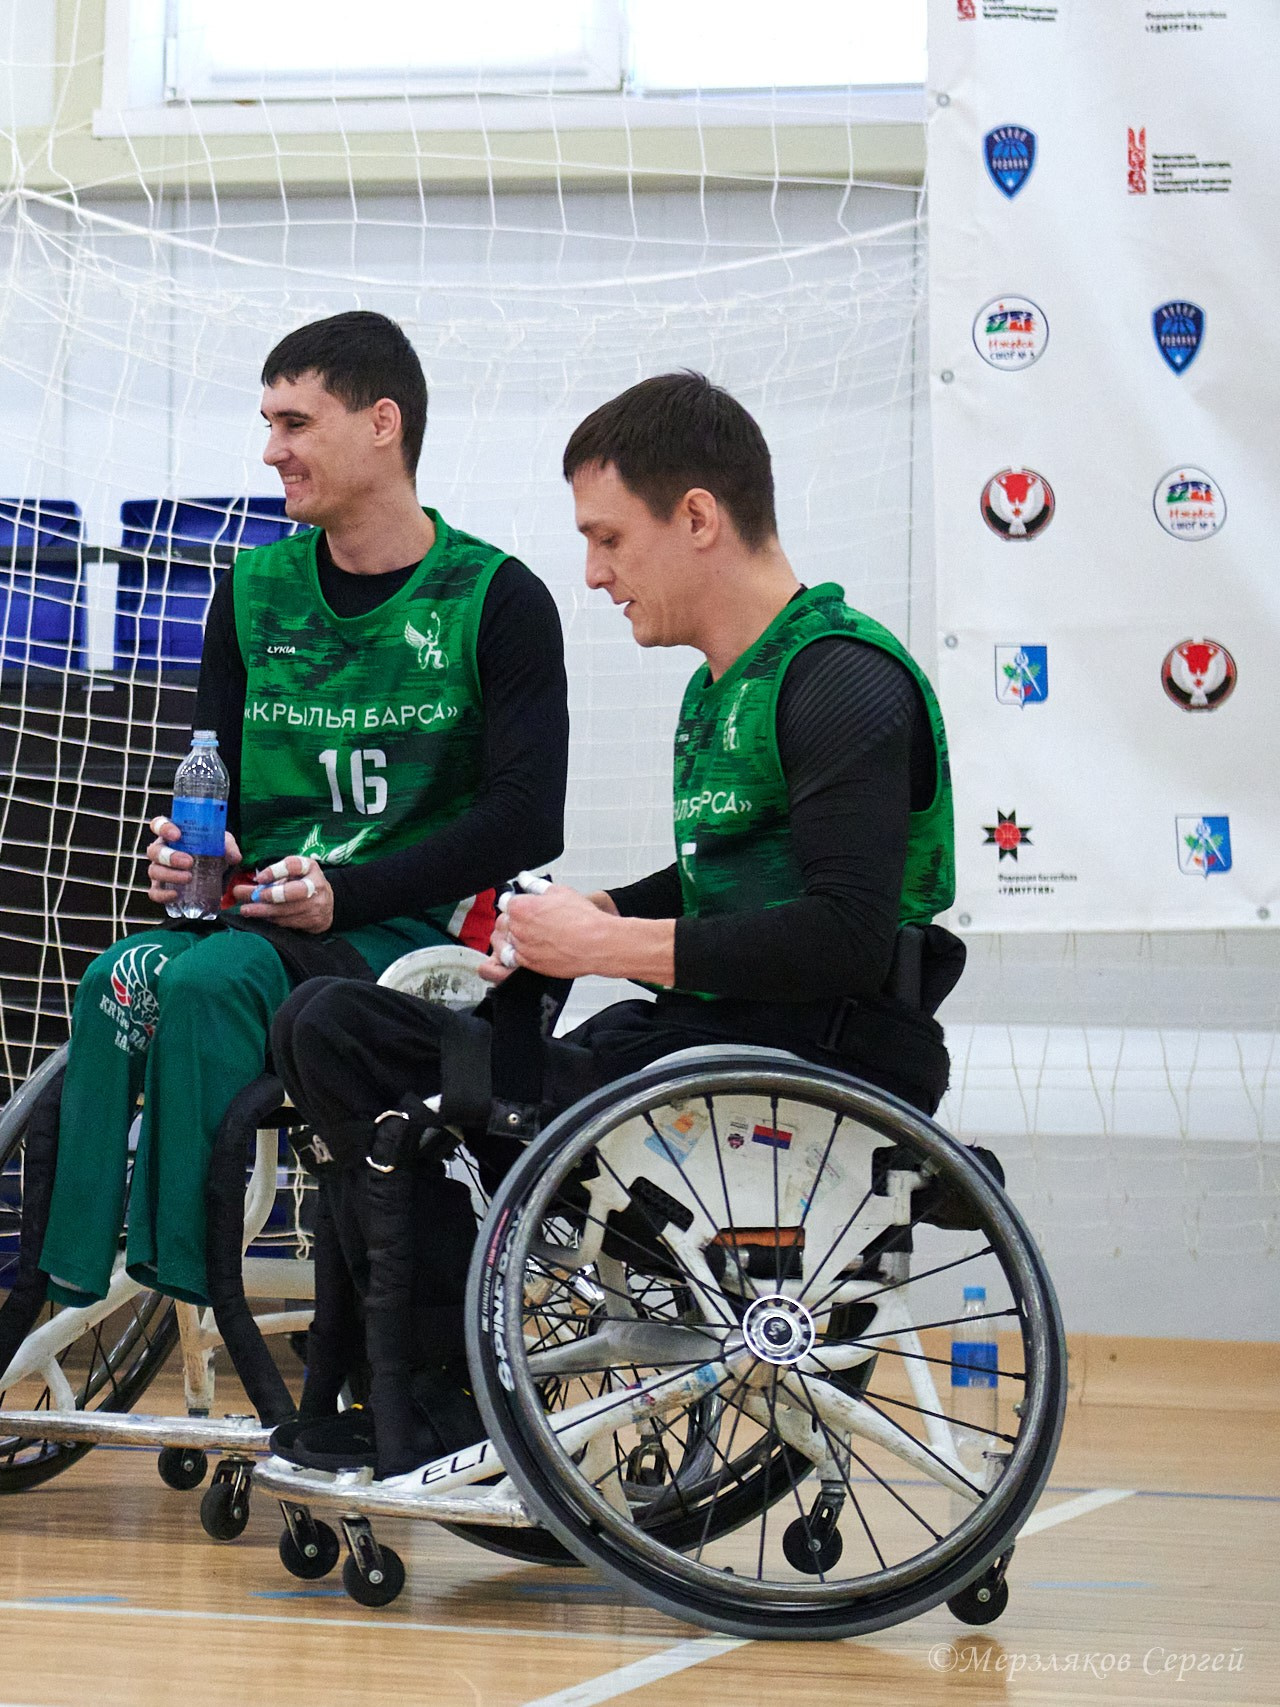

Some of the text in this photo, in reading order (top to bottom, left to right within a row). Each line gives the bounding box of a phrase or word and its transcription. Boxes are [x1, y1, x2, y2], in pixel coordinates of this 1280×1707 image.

[266, 645, 296, 654] LYKIA
[244, 701, 458, 729] «КРЫЛЬЯ БАРСА»
[318, 748, 388, 815] 16
